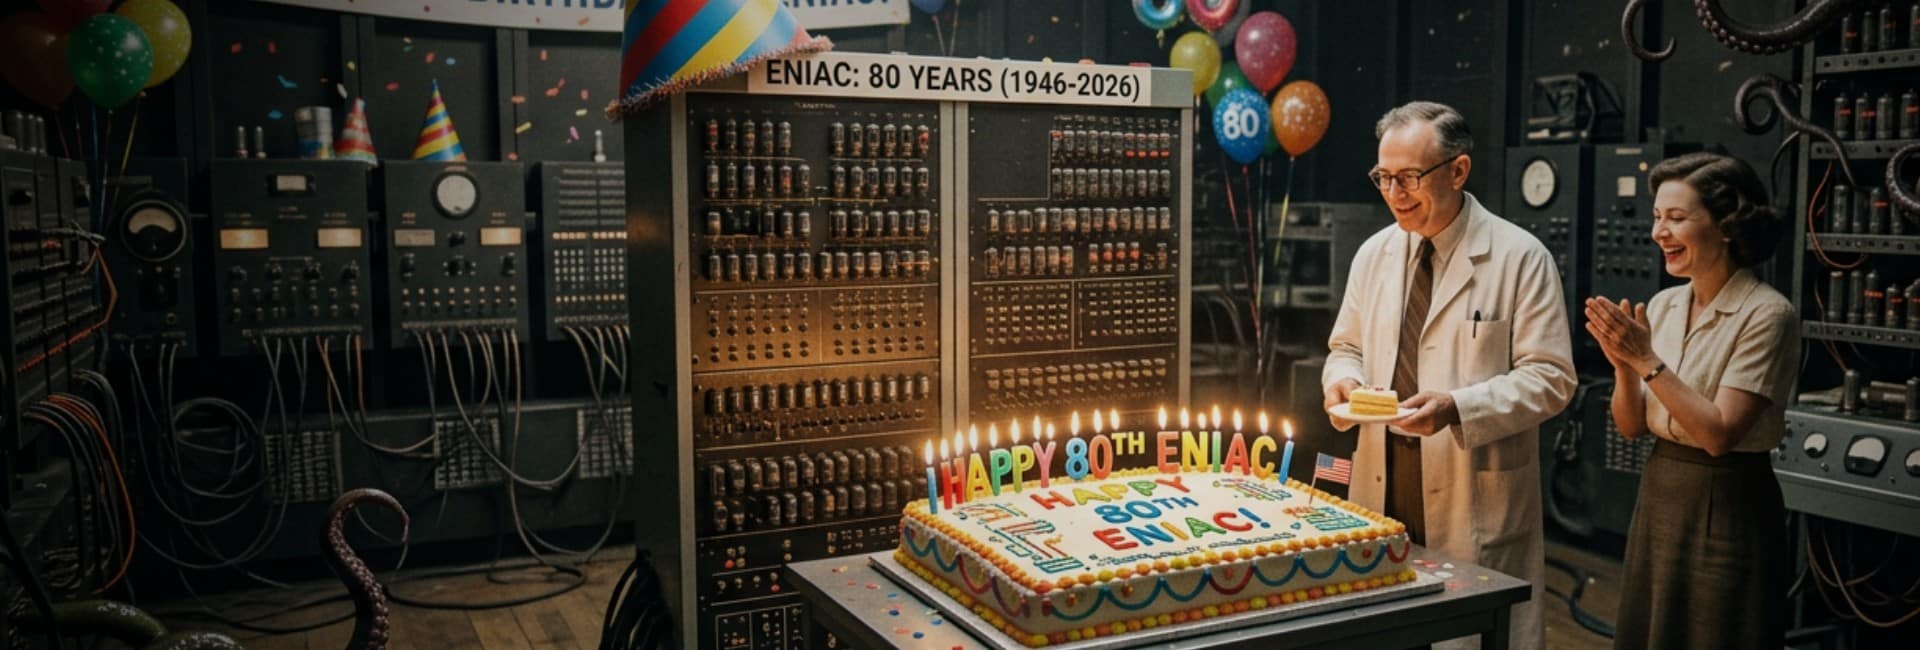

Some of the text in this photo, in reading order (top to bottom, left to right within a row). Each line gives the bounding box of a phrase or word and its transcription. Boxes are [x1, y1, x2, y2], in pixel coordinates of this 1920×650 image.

[766, 59, 1140, 102] ENIAC: 80 YEARS (1946-2026)
[1222, 107, 1260, 140] 80
[940, 440, 1057, 510] HAPPY
[1065, 431, 1145, 481] 80TH
[1029, 476, 1191, 510] HAPPY
[1094, 496, 1199, 524] 80TH
[1093, 507, 1271, 550] ENIAC!
